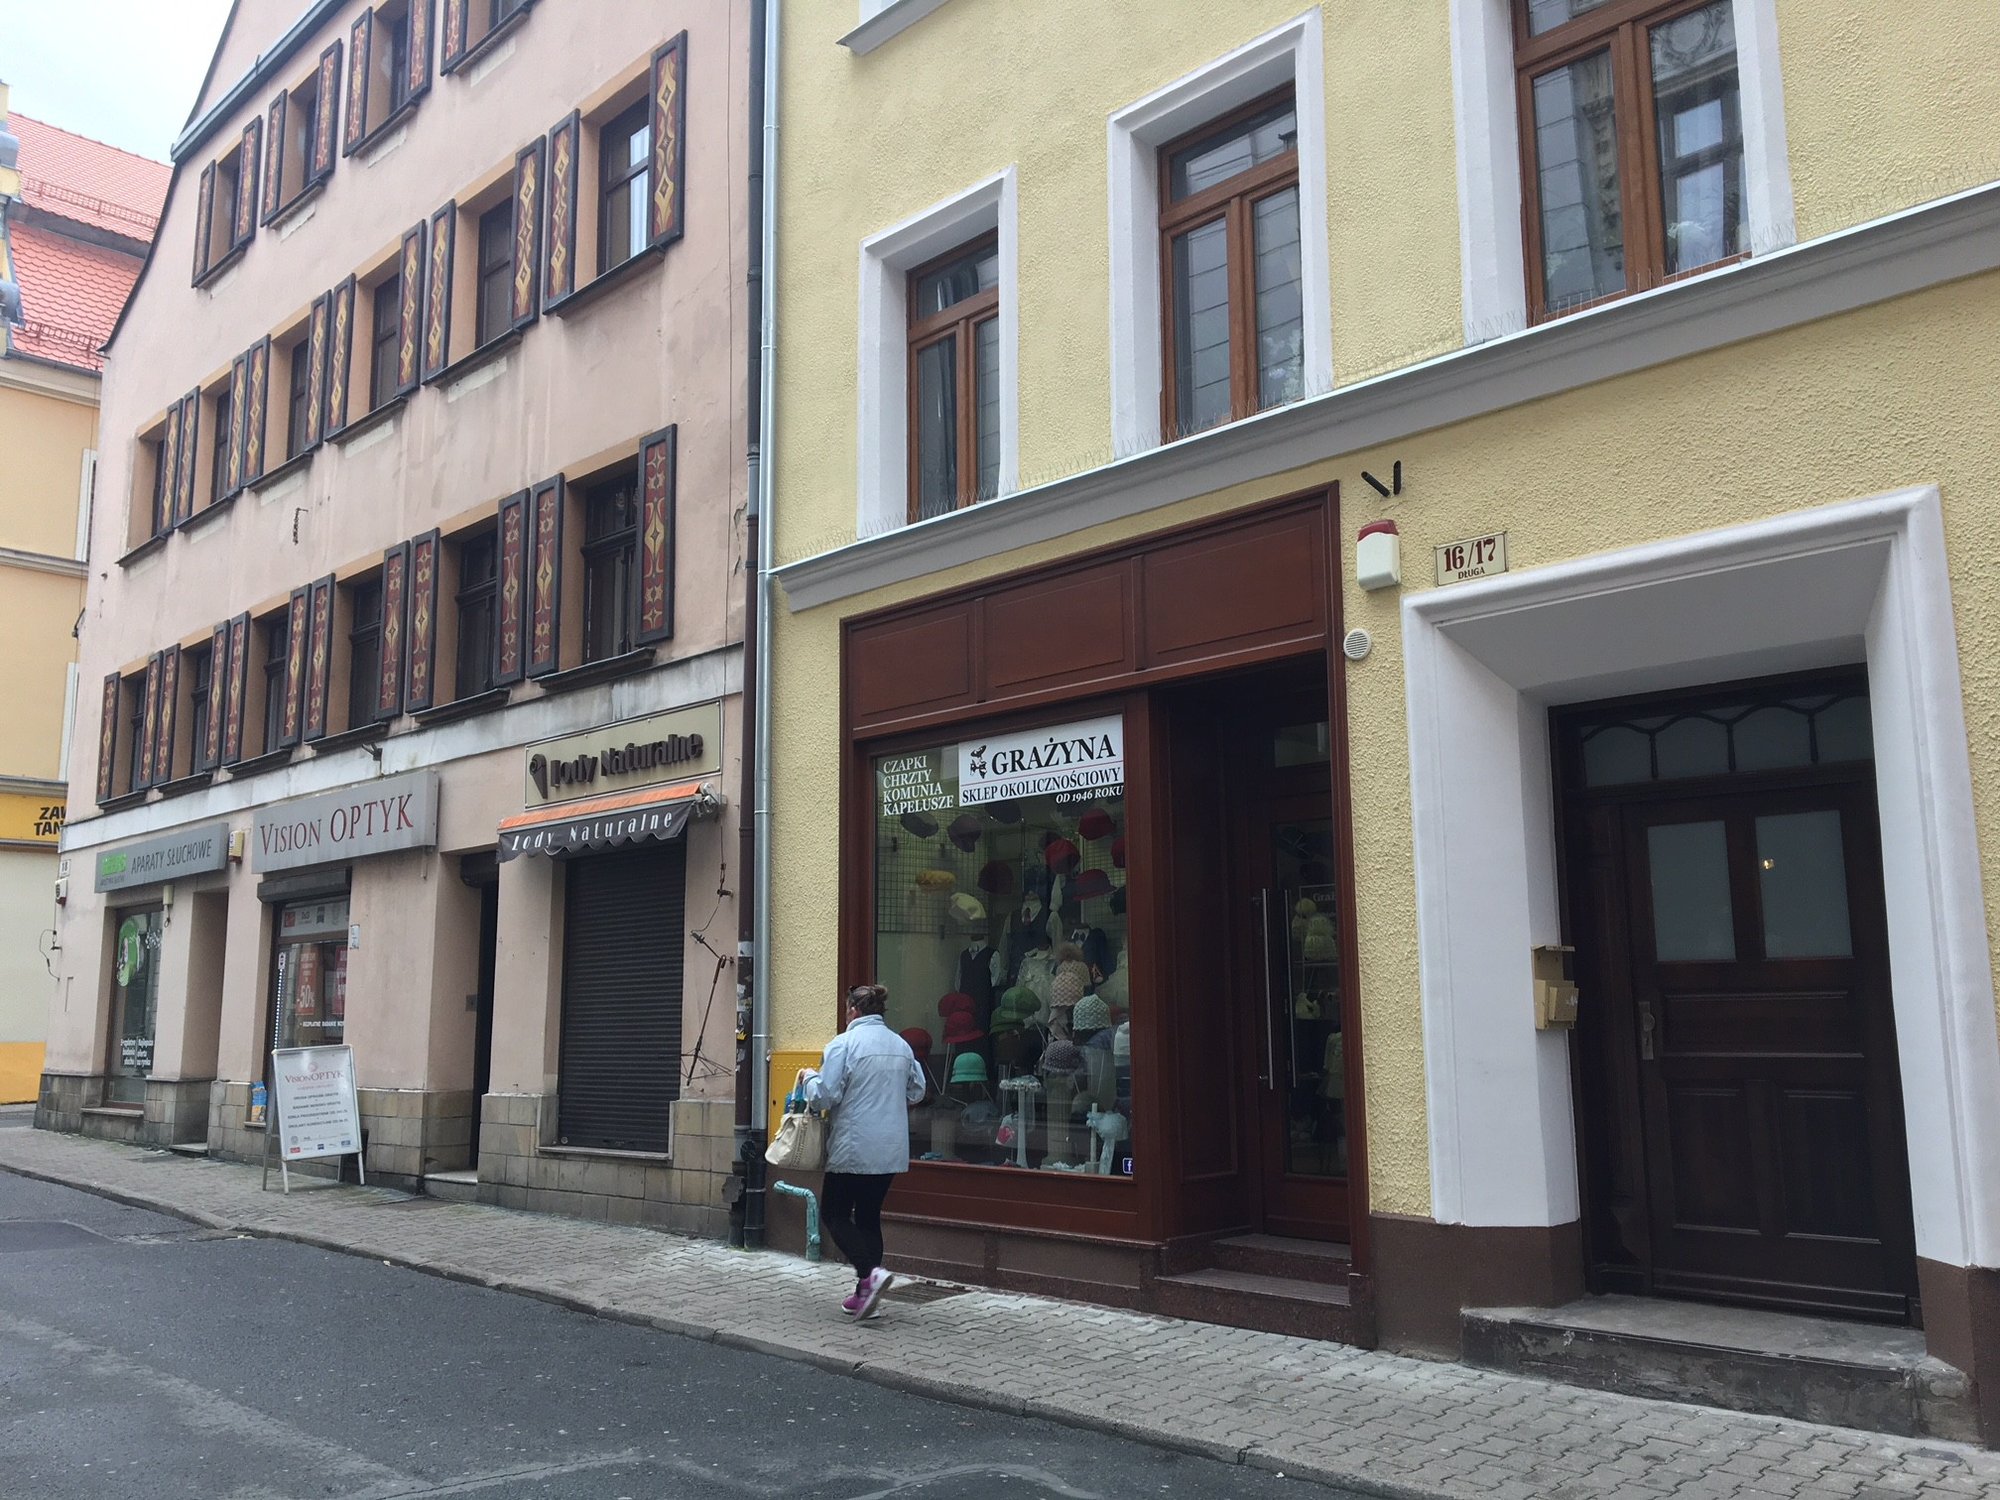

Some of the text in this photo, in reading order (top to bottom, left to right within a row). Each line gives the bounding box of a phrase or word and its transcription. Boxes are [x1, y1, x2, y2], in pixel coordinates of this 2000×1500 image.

[1444, 537, 1496, 572] 16/17
[1457, 566, 1486, 580] DŁUGA
[550, 733, 704, 788] Lody Naturalne
[883, 755, 928, 774] CZAPKI
[991, 736, 1117, 776] GRAŻYNA
[883, 769, 932, 788] CHRZTY
[883, 782, 943, 803] KOMUNIA
[962, 767, 1121, 804] SKLEP OKOLICZNOŚCIOWY
[1055, 785, 1124, 804] OD 1946 ROKU
[883, 795, 954, 817] KAPELUSZE
[260, 793, 414, 855] VISION OPTYK
[511, 812, 673, 851] Lody Naturalne
[131, 850, 165, 875] APARATY
[166, 839, 212, 867] SŁUCHOWE
